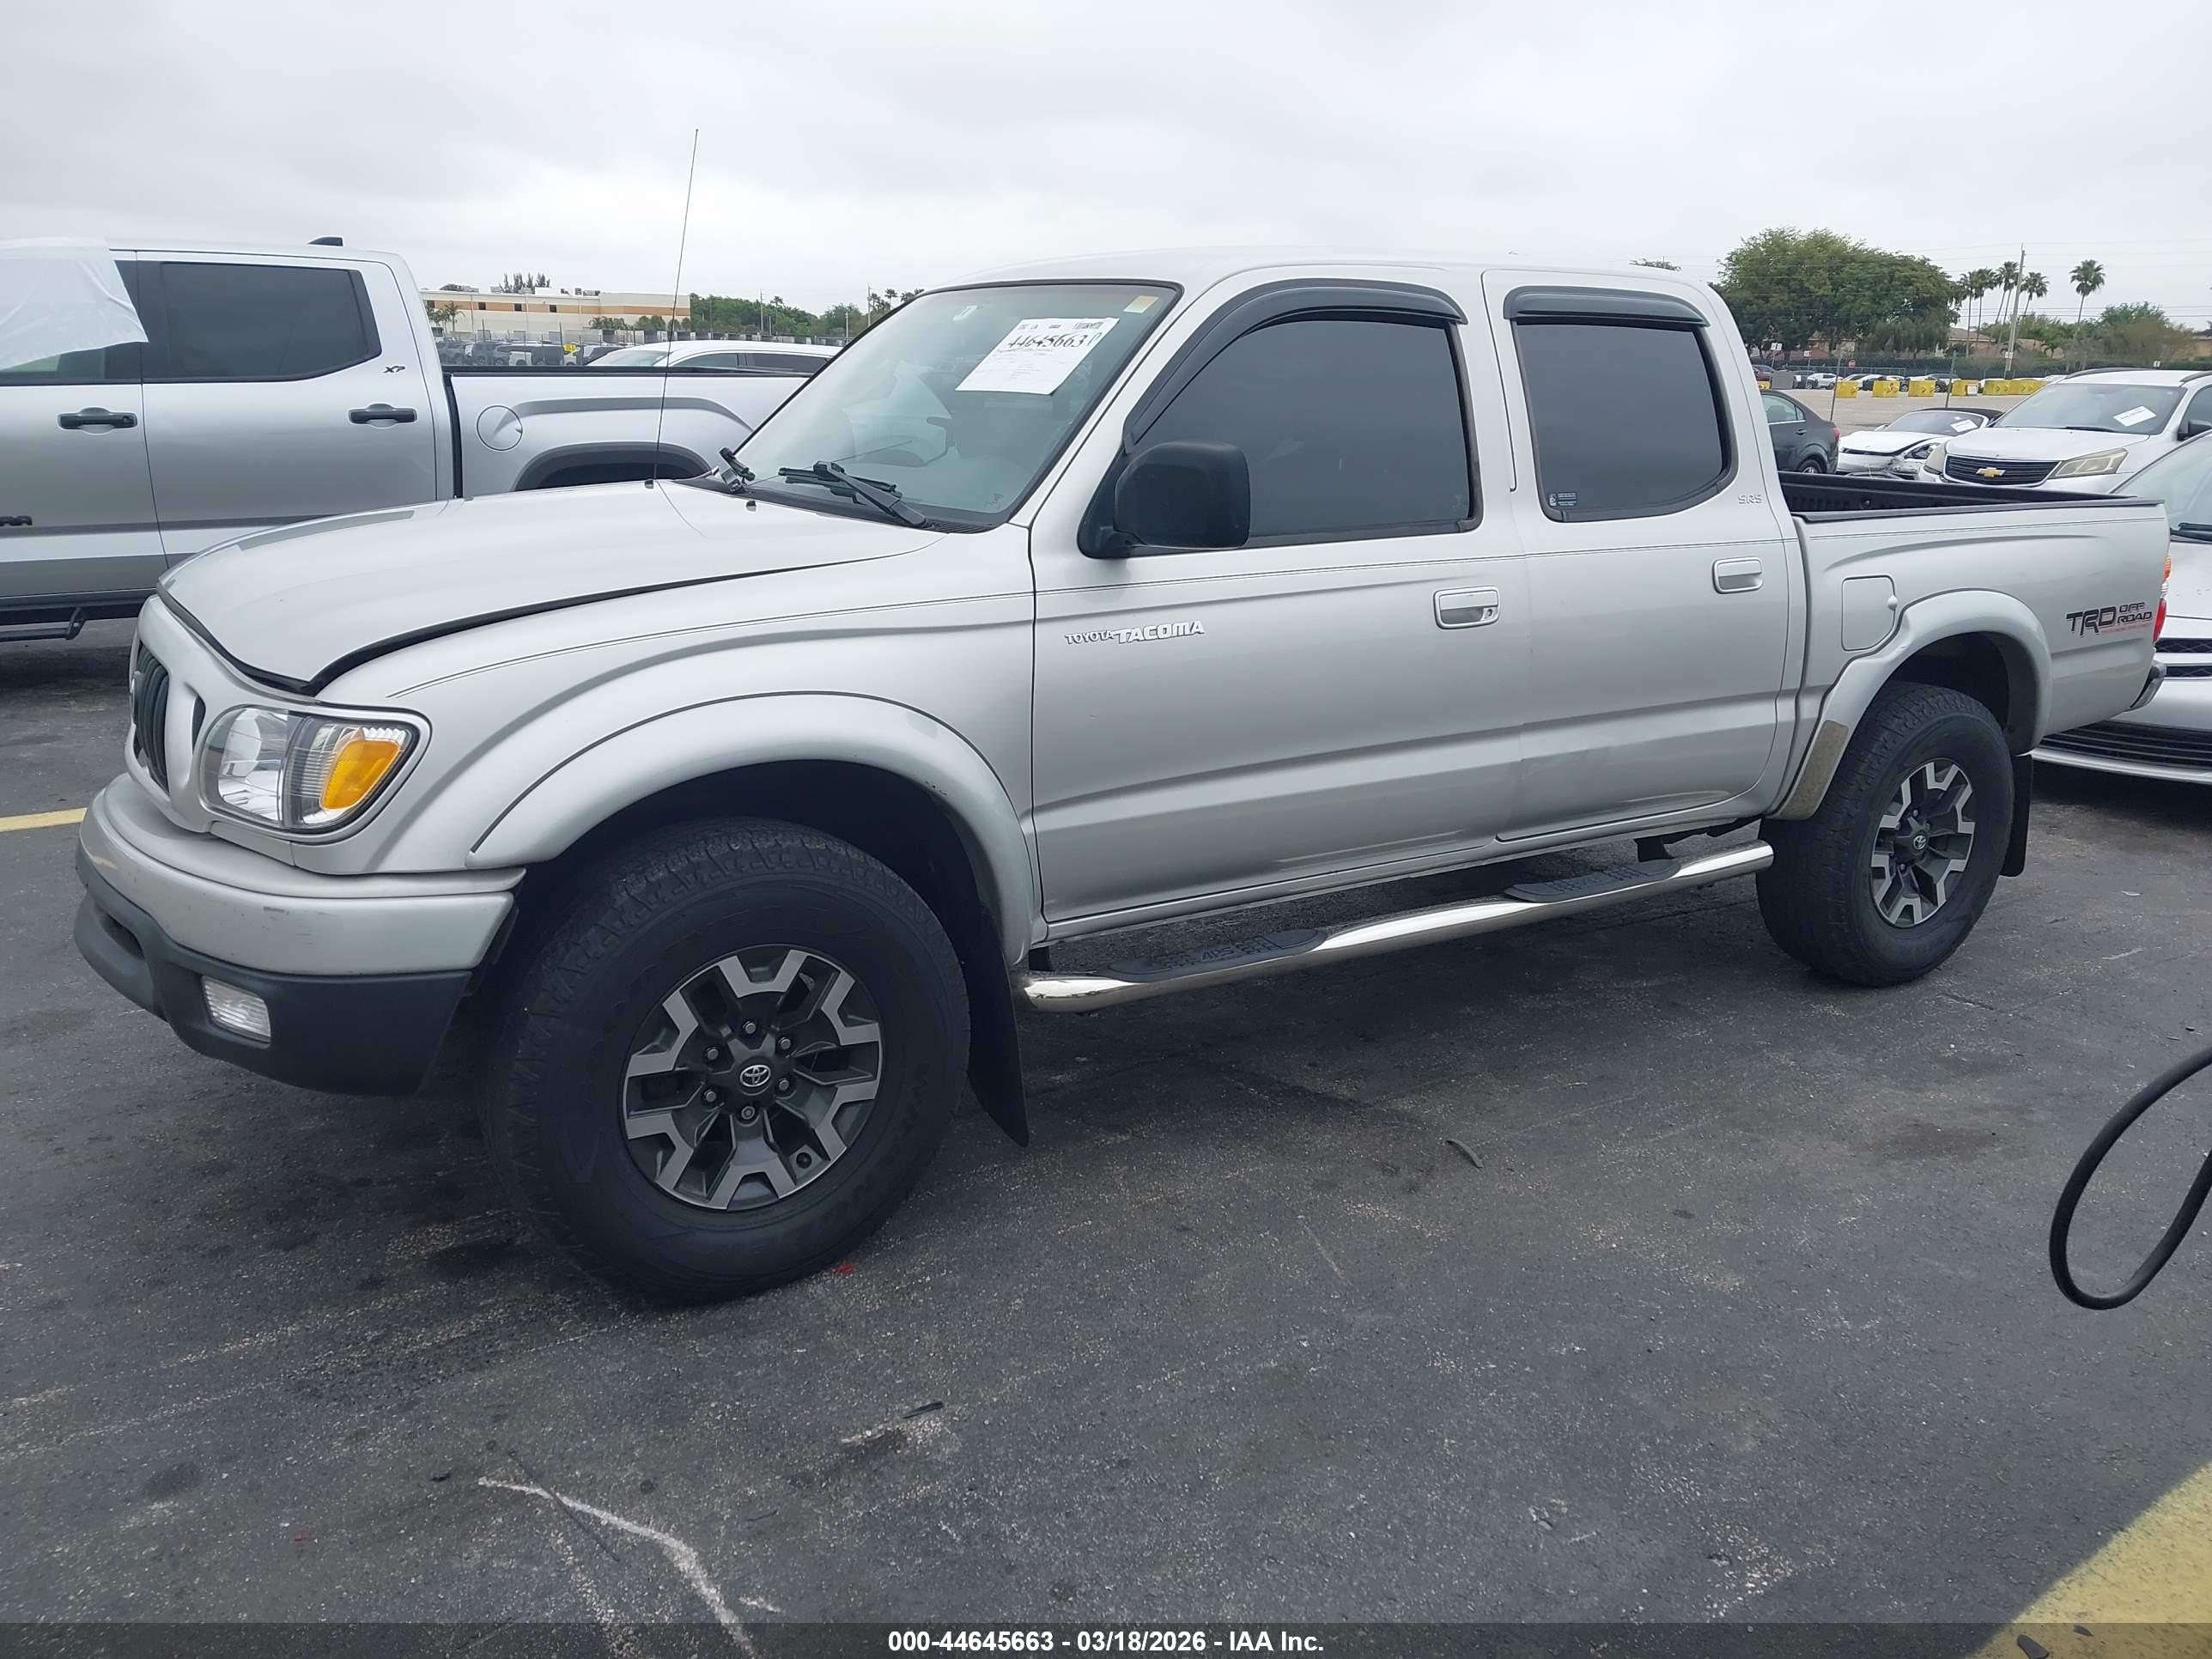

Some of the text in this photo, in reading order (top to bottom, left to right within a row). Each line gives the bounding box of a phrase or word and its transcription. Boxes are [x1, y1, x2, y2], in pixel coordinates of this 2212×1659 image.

[1007, 333, 1088, 348] 44645663
[383, 365, 405, 374] XP
[2118, 601, 2146, 613] OFF
[2065, 605, 2117, 637] TRD
[2117, 611, 2153, 624] ROAD
[1064, 621, 1206, 645] TOYOTA TACOMA
